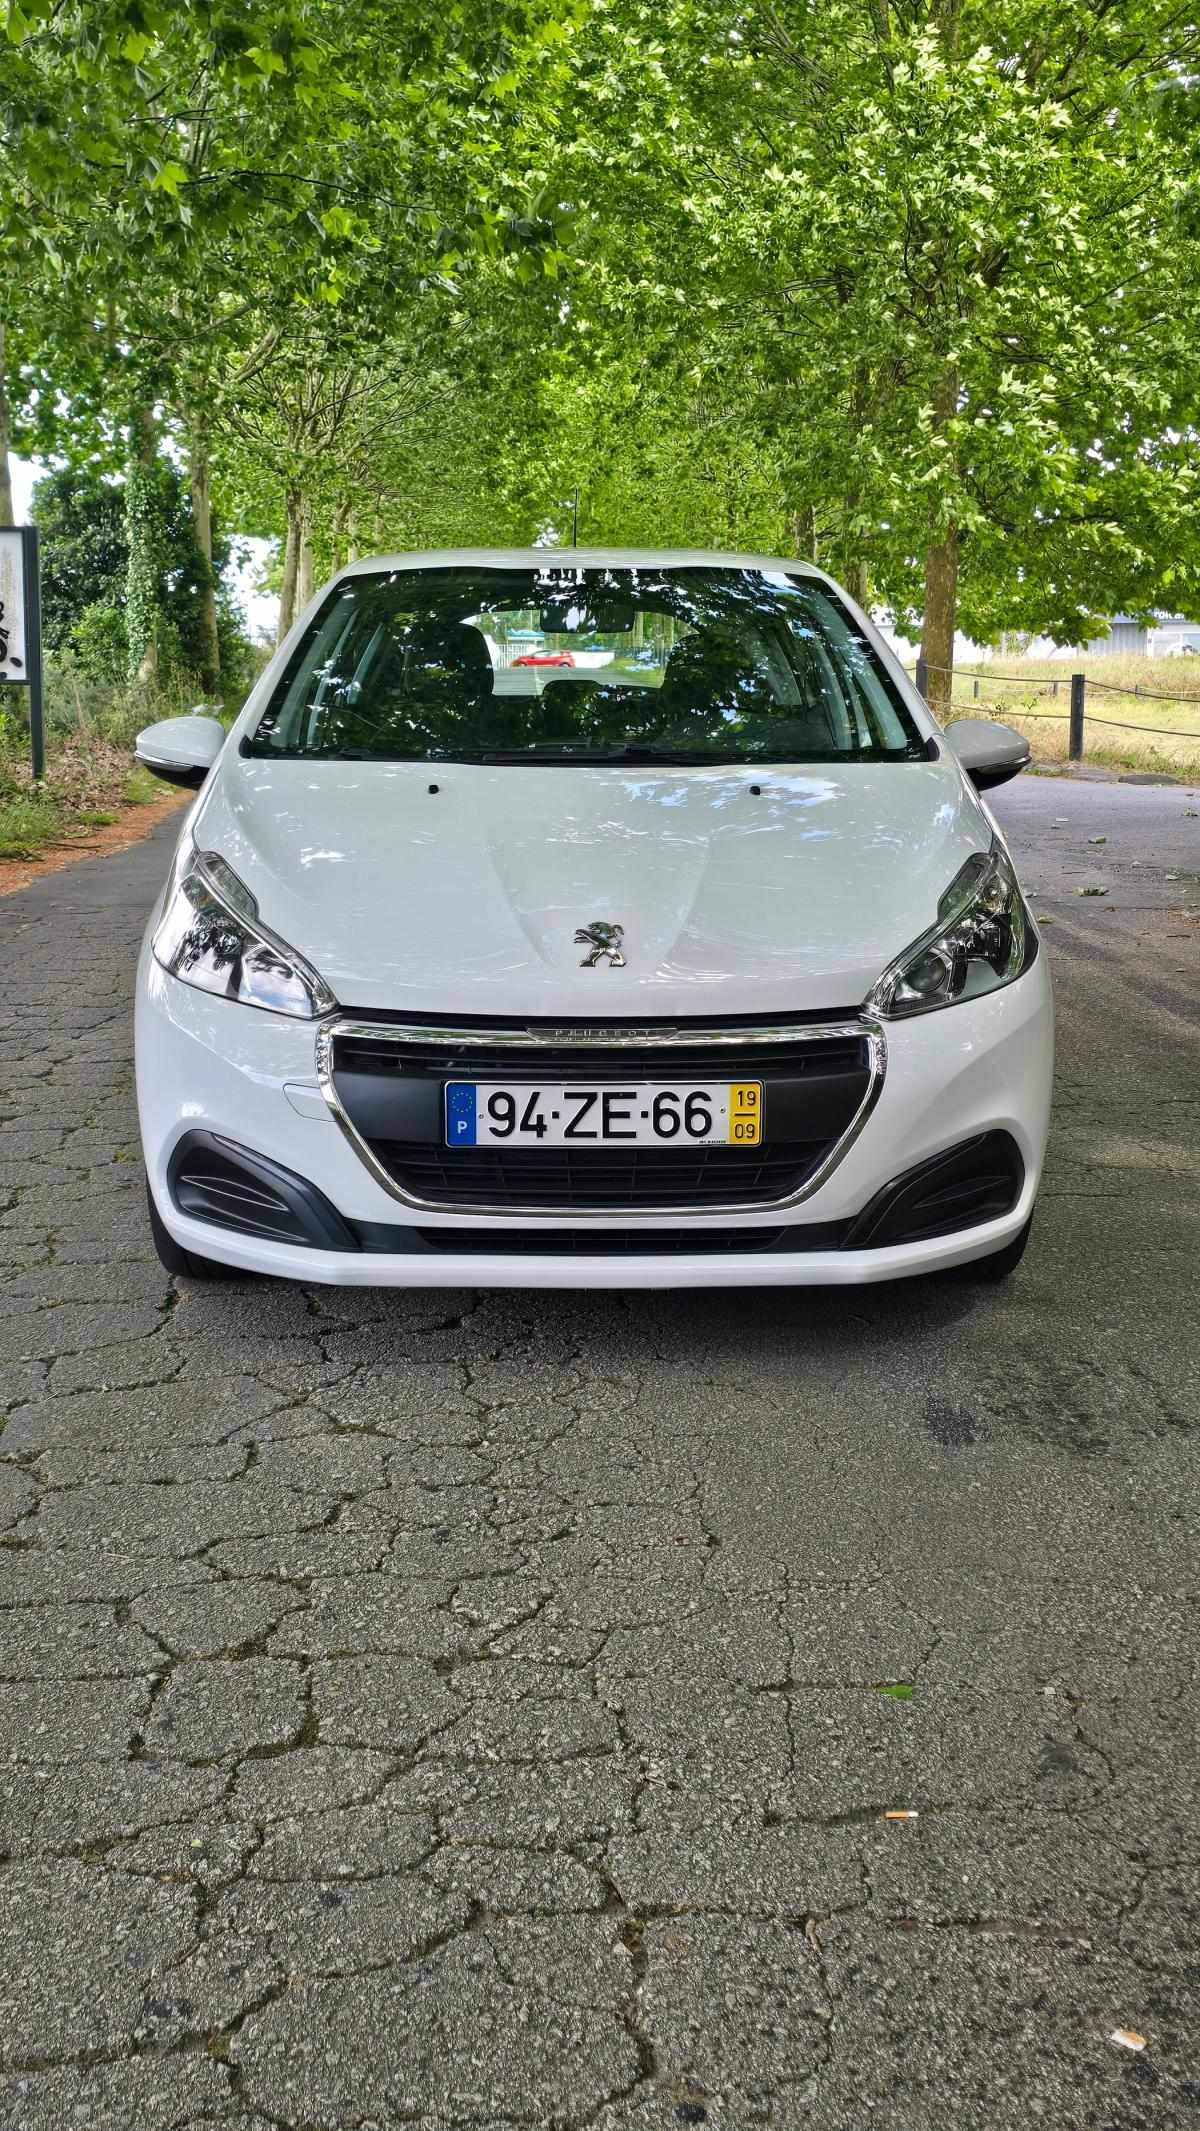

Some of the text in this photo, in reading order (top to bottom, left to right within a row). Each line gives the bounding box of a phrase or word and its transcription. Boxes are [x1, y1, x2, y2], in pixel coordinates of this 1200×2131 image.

[737, 1090, 757, 1107] 19
[457, 1120, 468, 1134] P
[734, 1123, 756, 1139] 09
